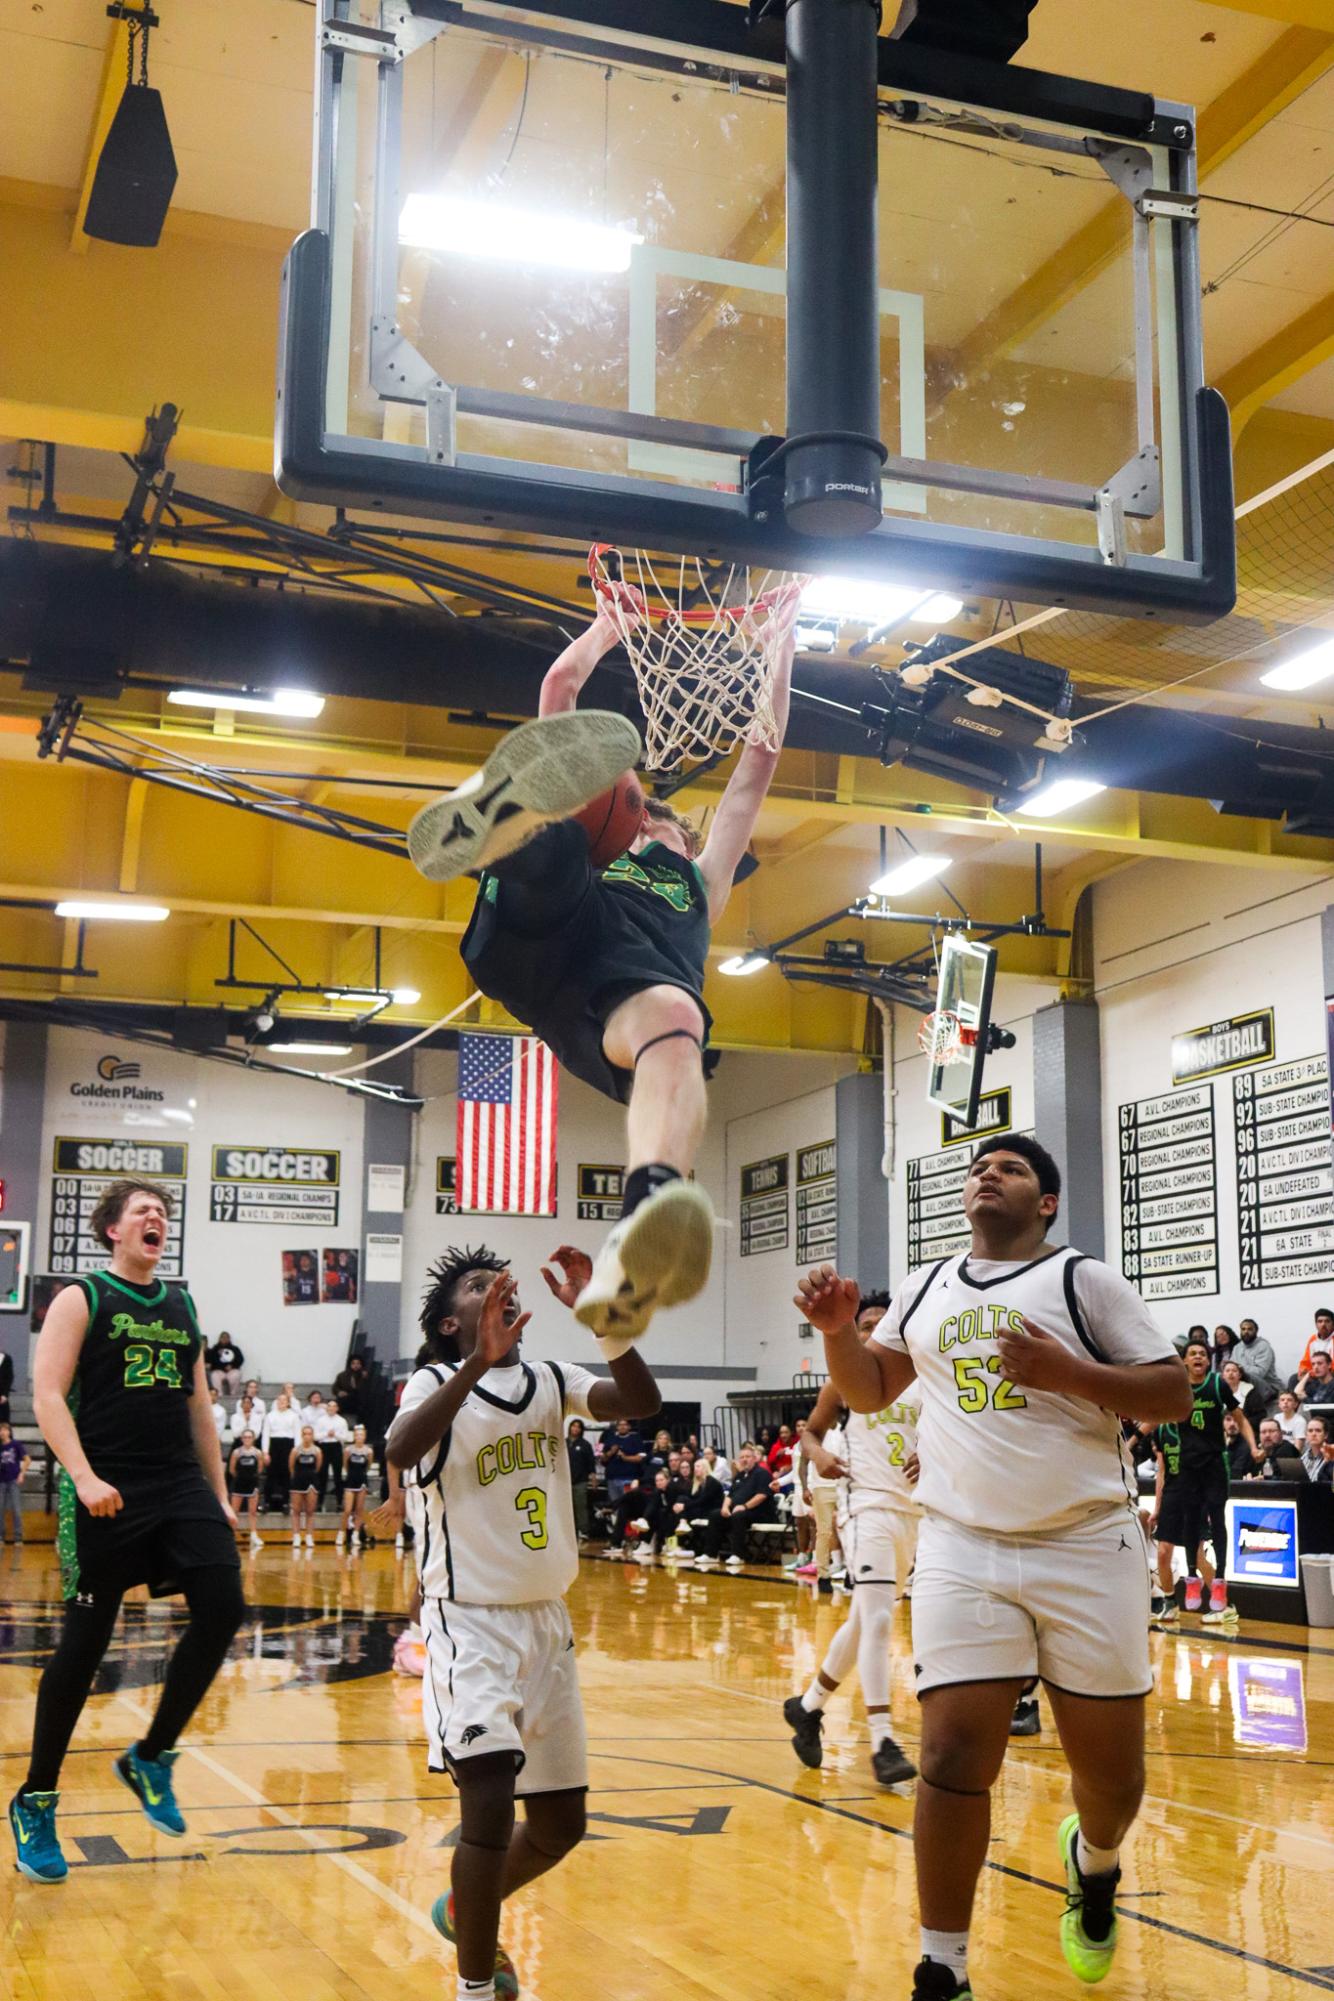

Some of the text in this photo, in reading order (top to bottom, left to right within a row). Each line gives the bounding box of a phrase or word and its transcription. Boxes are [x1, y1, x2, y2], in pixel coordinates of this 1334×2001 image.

[1212, 1021, 1230, 1034] BOYS
[1184, 1021, 1266, 1069] ASKETBALL
[70, 1082, 164, 1101] Golden Plains
[1235, 1073, 1252, 1100] 89
[1262, 1075, 1272, 1088] 5A
[1274, 1068, 1294, 1085] STATE
[1307, 1060, 1327, 1076] PLAC
[1121, 1103, 1135, 1128] 67
[1162, 1093, 1200, 1113] CHAMPIONS
[1236, 1089, 1329, 1127] 92 SUB-STATE CHAMPIO
[1121, 1118, 1209, 1152] 67 REGIONAL CHAMPIONS
[1237, 1116, 1330, 1153] 96 SUB-STATE CHAMPIO
[77, 1144, 164, 1173] SOCCER
[226, 1151, 329, 1181] SOCCER
[908, 1159, 918, 1180] 77
[937, 1152, 965, 1168] CHAMPIONS
[1122, 1144, 1210, 1177] 70 REGIONAL CHAMPIONS
[1239, 1154, 1256, 1180] 20
[56, 1179, 78, 1196] 00
[214, 1186, 235, 1203] 03
[268, 1192, 300, 1201] REGIONAL
[302, 1193, 332, 1203] CHAMPS
[908, 1180, 919, 1199] 77
[944, 1176, 967, 1187] CHAMPION
[1122, 1170, 1211, 1202] 71 REGIONAL CHAMPIONS
[1239, 1176, 1320, 1207] 20 6A UNDEFEATED
[55, 1198, 77, 1215] 03
[214, 1204, 234, 1221] 17
[291, 1212, 332, 1222] CHAMPIONS
[440, 1197, 458, 1213] 73
[581, 1203, 598, 1219] 15
[909, 1202, 918, 1220] 81
[938, 1198, 962, 1210] CHAMPION
[1123, 1203, 1138, 1227] 82
[1176, 1196, 1211, 1214] CHAMPIONS
[53, 1217, 76, 1234] 06
[909, 1222, 919, 1241] 89
[938, 1219, 965, 1231] CHAMPIONS
[1240, 1209, 1256, 1234] 21
[53, 1236, 74, 1253] 07
[909, 1243, 918, 1262] 91
[945, 1239, 971, 1251] CHAMPIONS
[1124, 1228, 1138, 1252] 83
[1166, 1224, 1205, 1240] CHAMPIONS
[1241, 1236, 1257, 1261] 21
[1276, 1238, 1286, 1252] 6A
[1290, 1235, 1312, 1249] STATE
[52, 1255, 74, 1272] 09
[1124, 1249, 1213, 1277] 88 5A STATE RUNNER-UP
[1167, 1277, 1206, 1292] CHAMPIONS
[1242, 1264, 1259, 1289] 24
[1265, 1264, 1302, 1280] SUB-STATE
[939, 1304, 1025, 1353] COLTS
[124, 1345, 182, 1388] 24
[952, 1355, 1027, 1414] 52
[1191, 1410, 1205, 1430] 4
[886, 1432, 905, 1467] 2
[515, 1486, 549, 1551] 3
